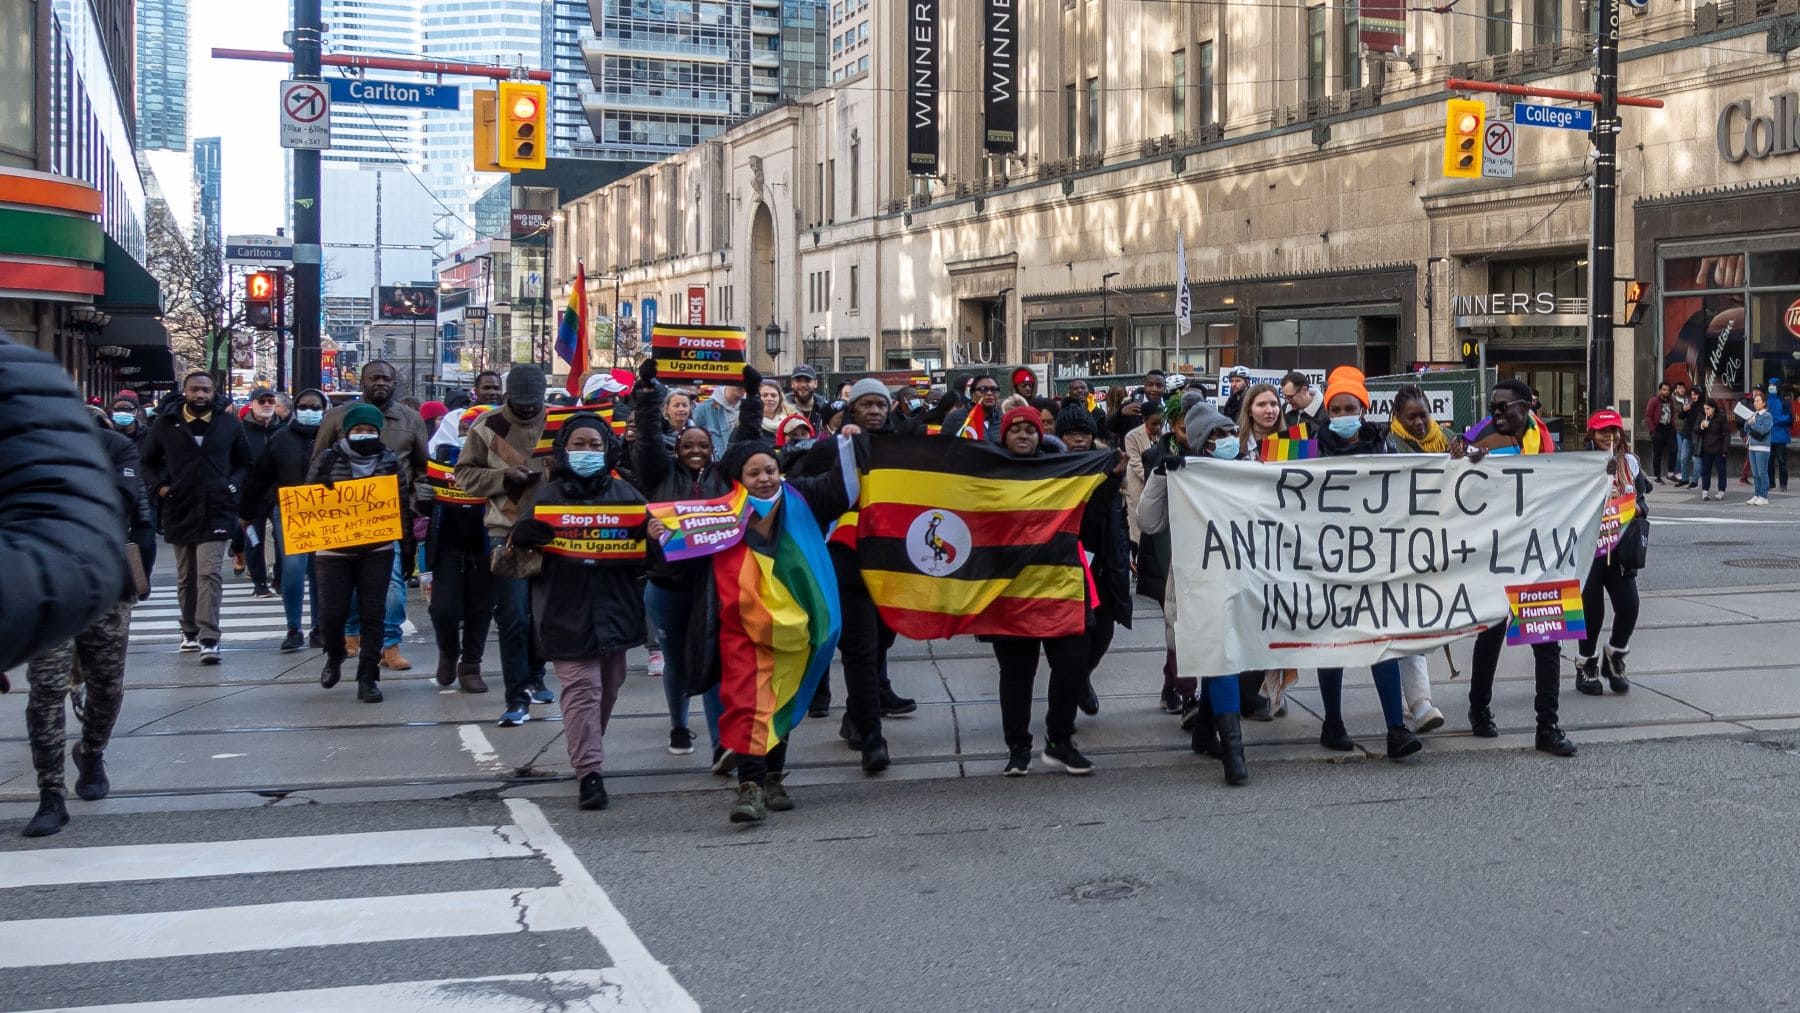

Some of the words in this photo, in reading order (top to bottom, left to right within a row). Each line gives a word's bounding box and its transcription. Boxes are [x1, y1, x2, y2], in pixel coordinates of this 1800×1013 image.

[350, 82, 420, 102] Carlton
[425, 87, 435, 96] St
[1526, 106, 1573, 127] College
[1575, 111, 1582, 119] St
[237, 247, 272, 257] Carlton
[467, 308, 486, 318] AURA
[690, 297, 703, 326] RICK
[679, 337, 725, 348] Protect
[681, 350, 721, 360] LGBTQ
[670, 361, 729, 372] Ugandans
[1305, 374, 1323, 384] ATE
[333, 483, 378, 504] YOUR
[1276, 468, 1535, 517] REJECT
[676, 504, 729, 515] Protect
[562, 514, 593, 526] Stop
[597, 514, 619, 524] the
[684, 516, 737, 529] Human
[290, 529, 315, 542] SIGN
[320, 524, 340, 536] THE
[693, 528, 740, 545] Rights
[570, 541, 582, 549] in
[586, 543, 637, 552] Uganda
[1202, 520, 1476, 574] ANTI-LGBTQI+
[1490, 527, 1578, 575] LAW
[1520, 590, 1559, 603] Protect
[1522, 605, 1561, 618] Human
[1526, 619, 1562, 634] Rights
